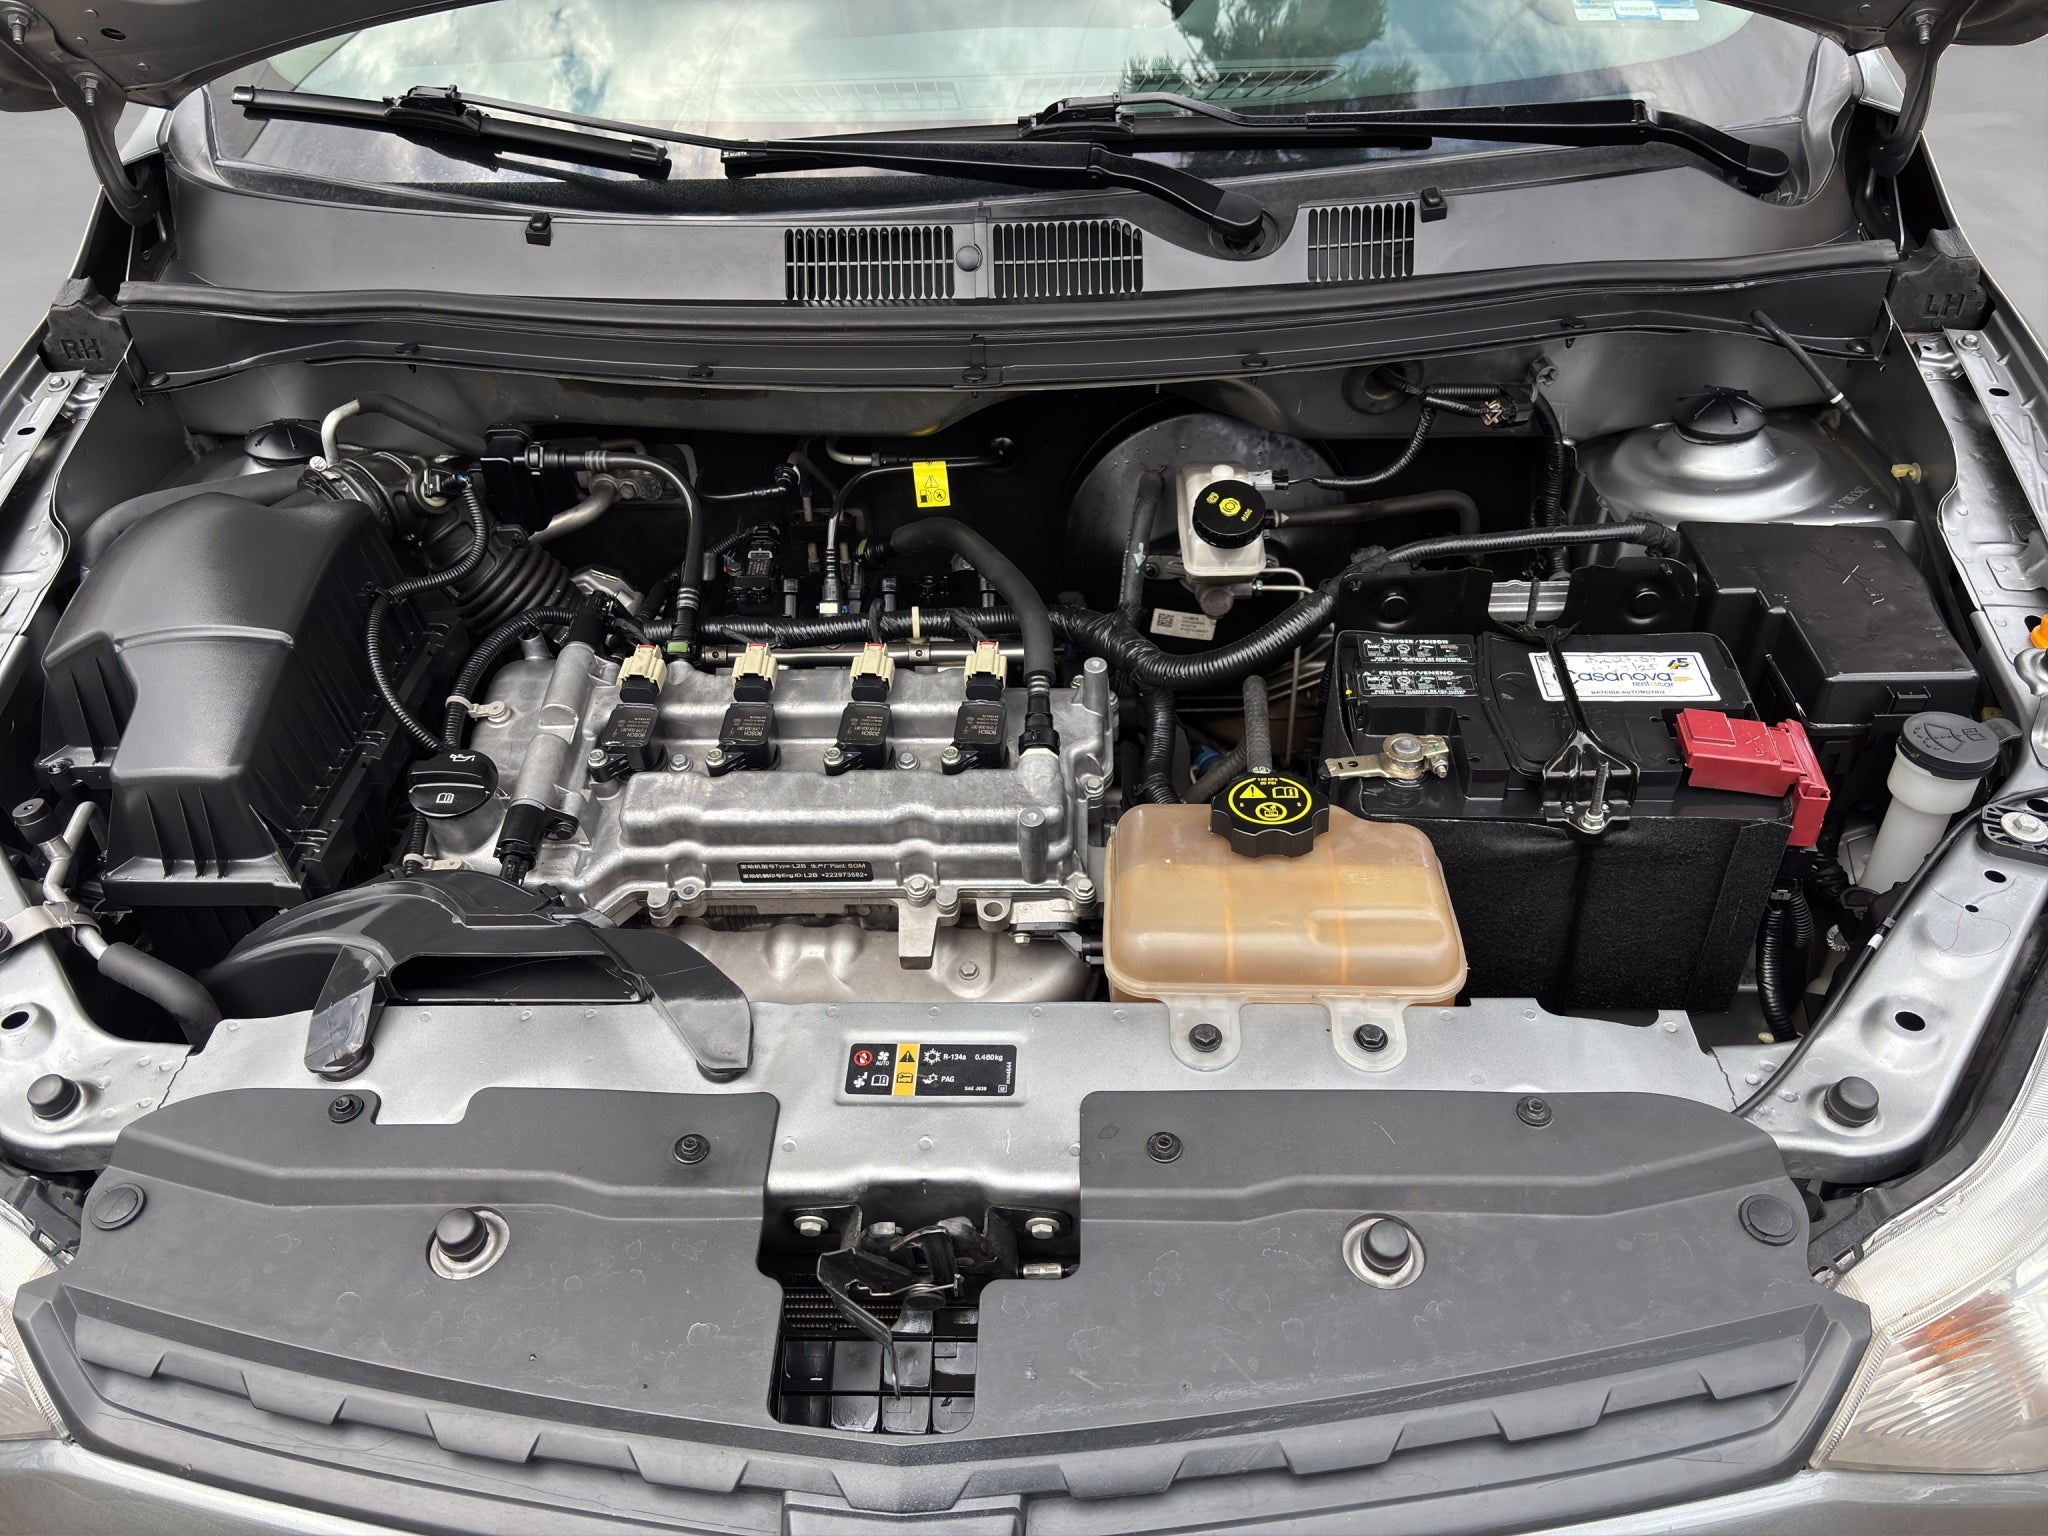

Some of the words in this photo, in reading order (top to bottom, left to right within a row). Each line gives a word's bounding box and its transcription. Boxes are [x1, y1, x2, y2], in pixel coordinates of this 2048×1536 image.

[1926, 294, 1966, 317] LH
[60, 339, 103, 359] RH
[943, 1053, 967, 1061] R-134a
